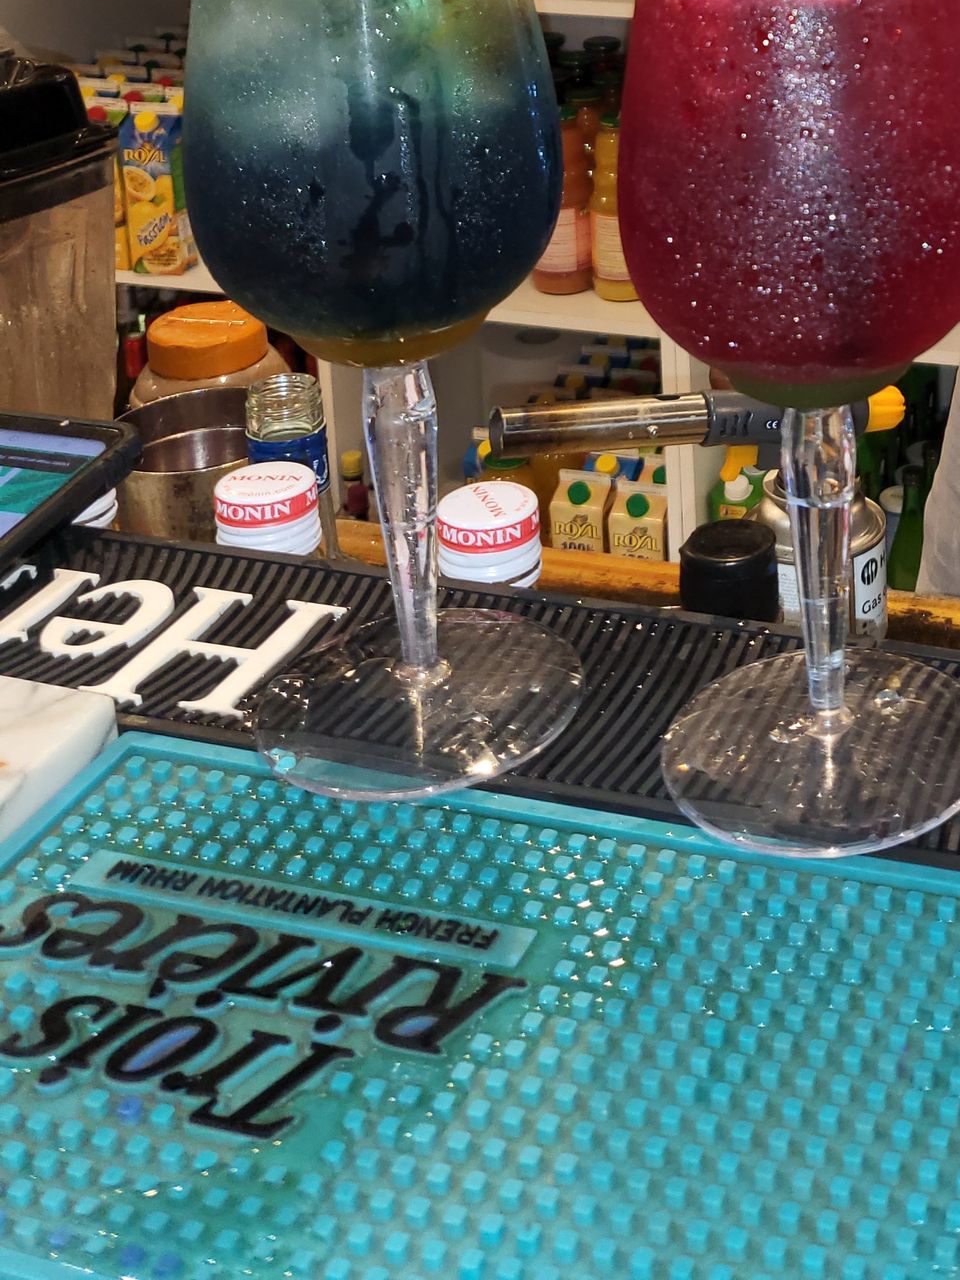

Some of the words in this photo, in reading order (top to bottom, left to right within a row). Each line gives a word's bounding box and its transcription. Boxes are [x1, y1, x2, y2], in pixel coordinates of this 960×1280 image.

[122, 144, 168, 166] ROYAL
[227, 474, 304, 483] MONIN
[215, 499, 292, 522] MONIN
[471, 485, 507, 519] MONIN
[442, 523, 522, 547] MONIN
[554, 520, 601, 541] ROYAL
[613, 534, 662, 553] ROYAL
[861, 592, 882, 615] Gas
[105, 857, 199, 895] RHUM
[198, 872, 376, 927] PLANTATION
[379, 907, 500, 951] FRENCH
[0, 995, 356, 1141] Trois
